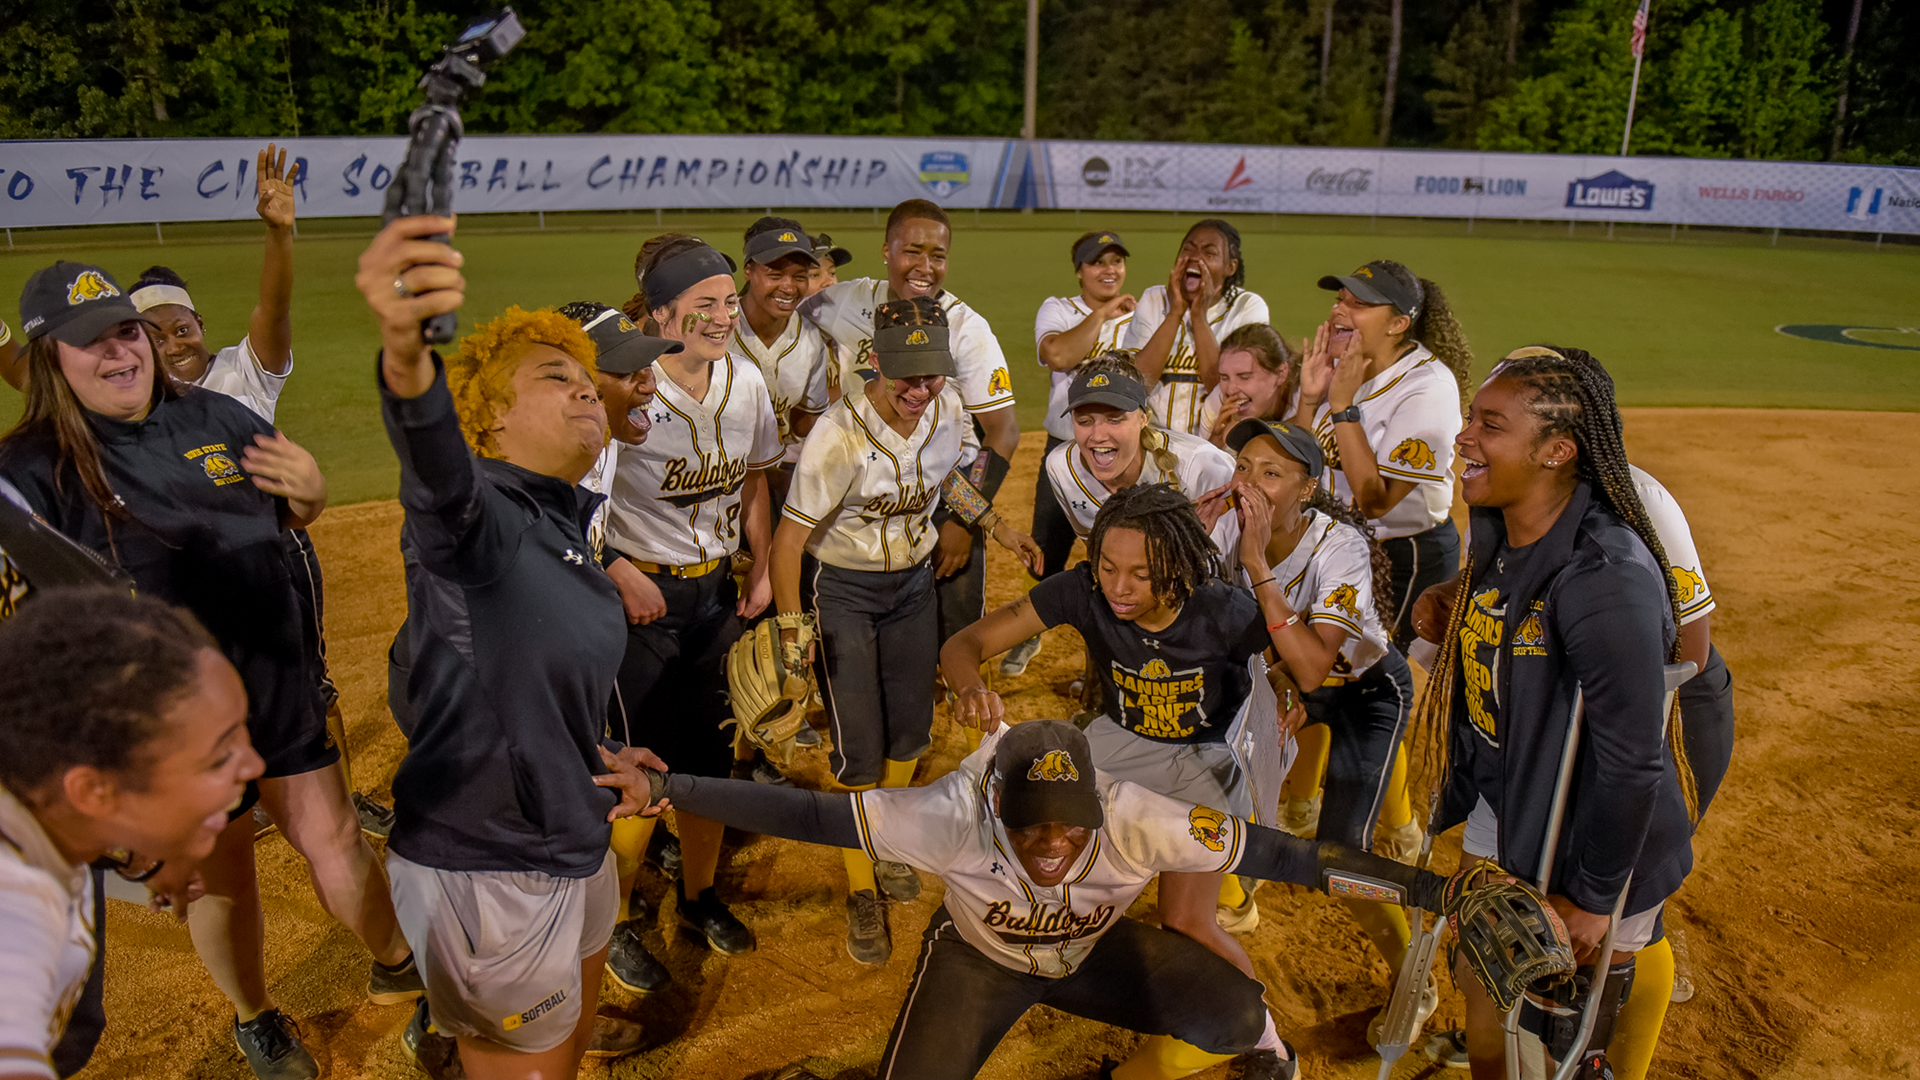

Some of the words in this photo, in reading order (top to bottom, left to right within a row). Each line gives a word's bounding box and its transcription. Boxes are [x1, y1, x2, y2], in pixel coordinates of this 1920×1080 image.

[0, 168, 35, 200] O
[65, 164, 164, 207] THE
[197, 157, 309, 204] CIA
[342, 153, 561, 197] SOBALL
[586, 150, 888, 195] CHAMPIONSHIP
[1415, 176, 1460, 195] FOOD
[1487, 177, 1528, 196] LION
[1575, 183, 1649, 208] LOWE'S
[1699, 186, 1750, 200] WELLS
[1753, 188, 1806, 203] FARGO
[660, 452, 745, 494] Bulldogs
[1112, 668, 1204, 697] BANNERS
[1134, 724, 1195, 739] GIVEN
[983, 900, 1115, 938] Bulldogs
[521, 989, 567, 1024] SOFTBALL
